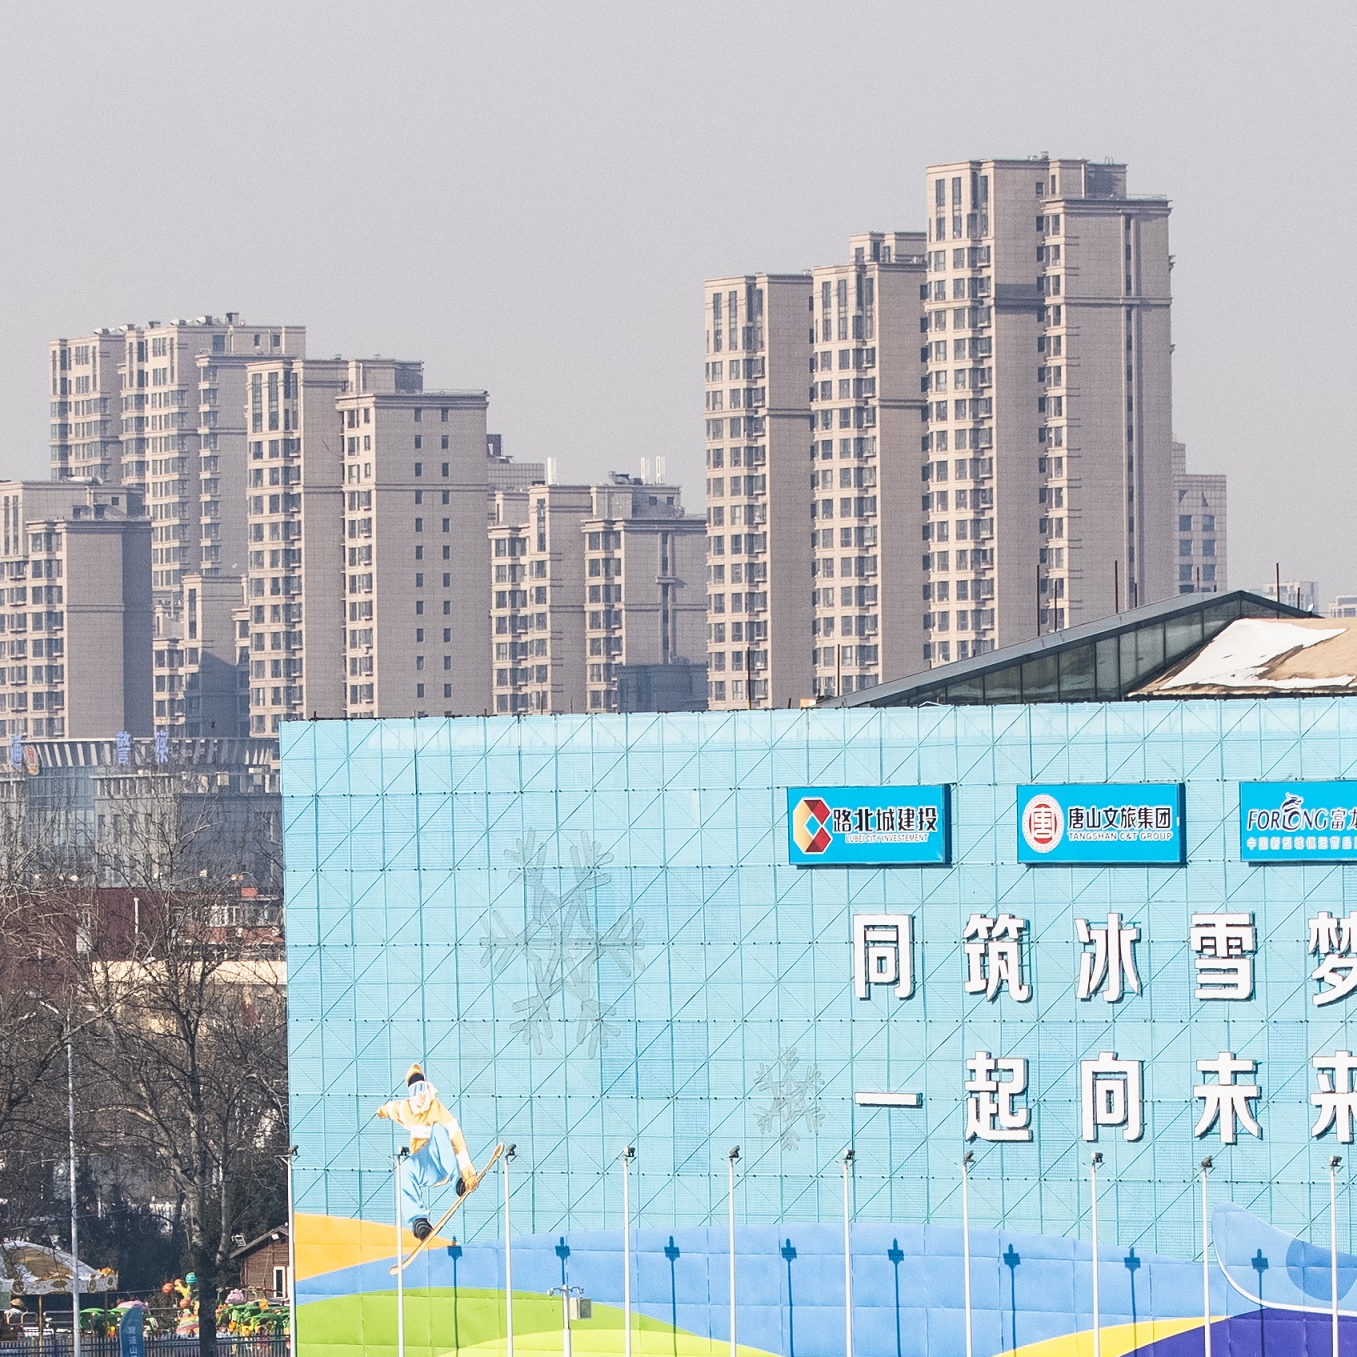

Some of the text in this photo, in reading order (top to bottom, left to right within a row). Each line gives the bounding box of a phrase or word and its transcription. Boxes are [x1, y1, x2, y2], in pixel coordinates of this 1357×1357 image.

[833, 807, 937, 832] 路北城建投
[1067, 805, 1171, 831] 唐山文旅集团
[865, 834, 881, 843] CITY
[1068, 833, 1118, 841] TANGSHAN
[1141, 832, 1173, 841] GROUP
